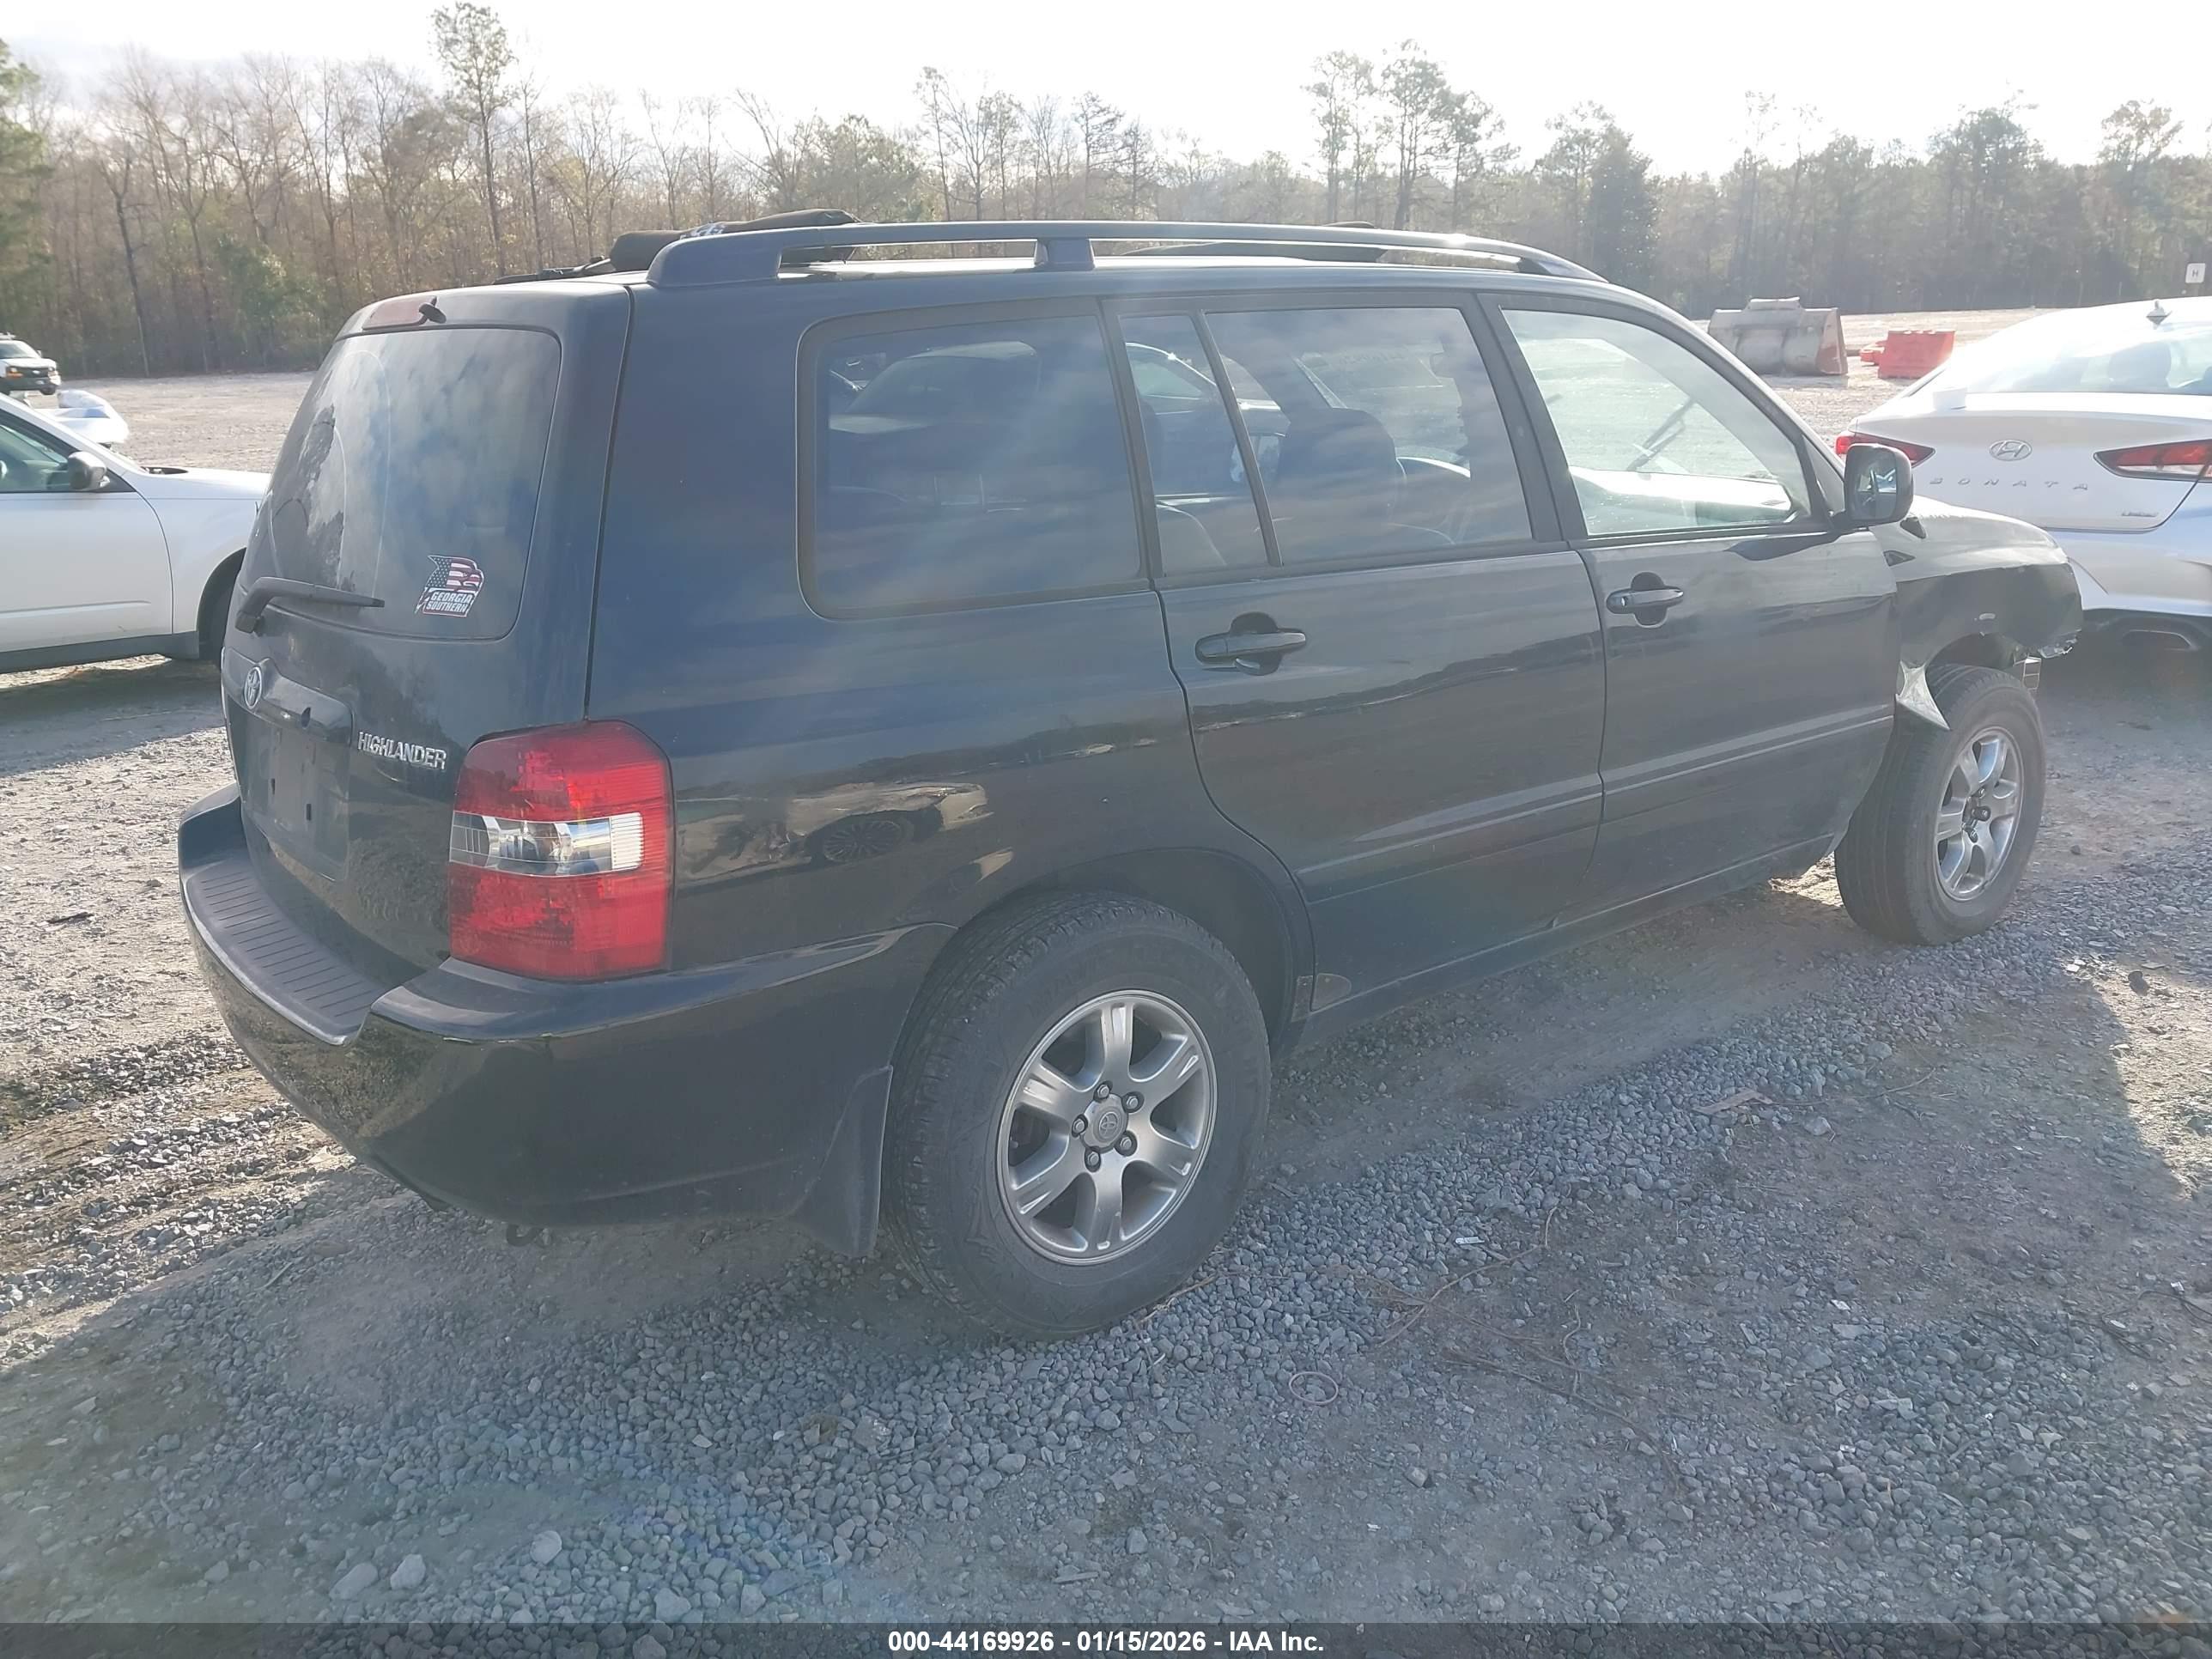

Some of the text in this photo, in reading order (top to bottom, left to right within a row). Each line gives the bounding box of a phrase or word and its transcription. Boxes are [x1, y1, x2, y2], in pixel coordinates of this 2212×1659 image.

[1929, 477, 2088, 491] SONATA
[430, 592, 473, 604] GEORGIA
[426, 600, 468, 613] SOUTHERN
[357, 731, 447, 770] HIGHLANDER
